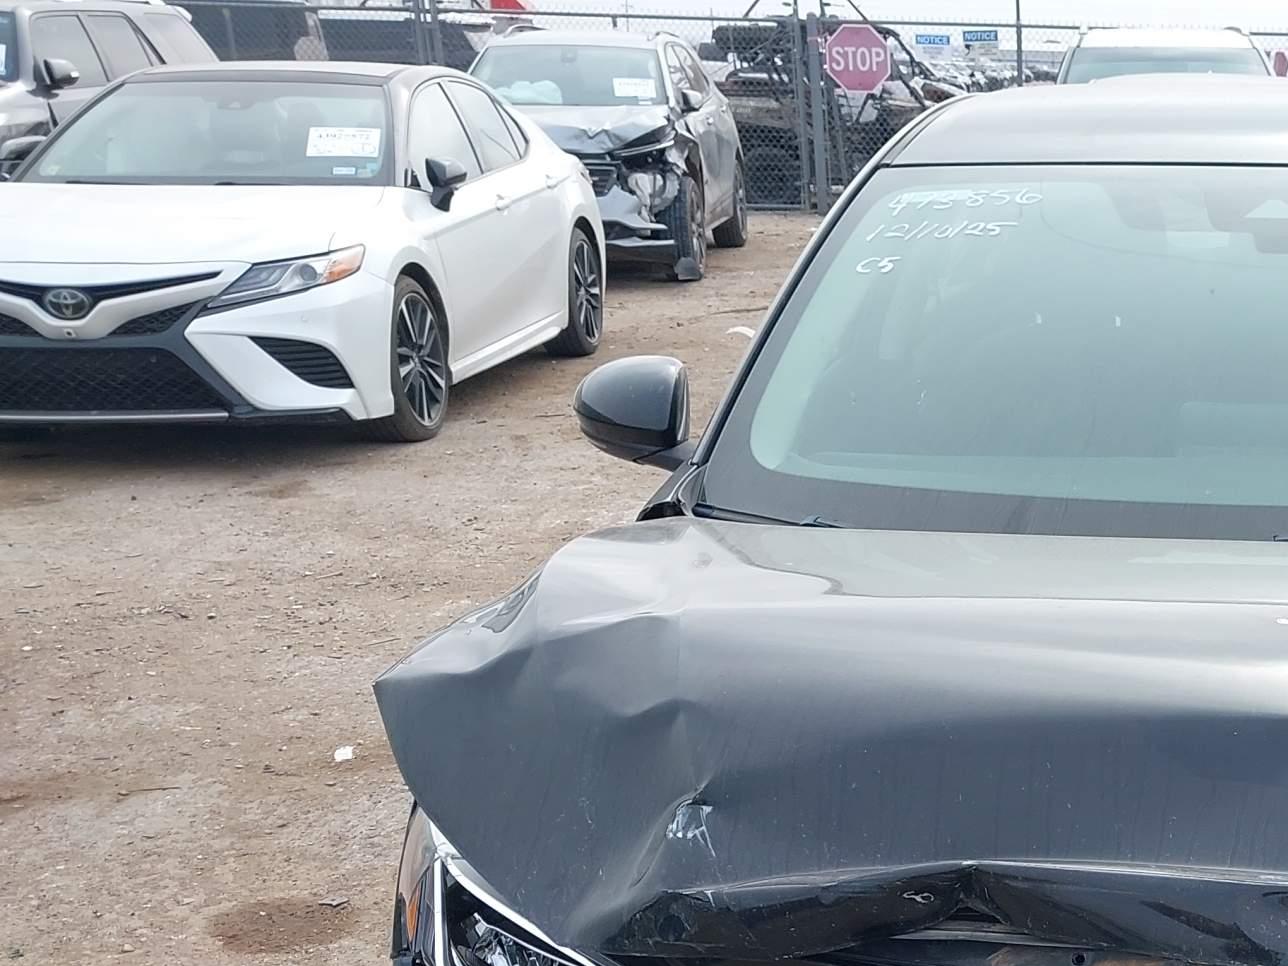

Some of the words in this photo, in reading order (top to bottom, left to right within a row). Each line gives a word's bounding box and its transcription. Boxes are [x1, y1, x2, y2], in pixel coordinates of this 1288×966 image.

[916, 36, 949, 46] NOTICE
[964, 32, 997, 41] NOTICE
[831, 47, 885, 72] STOP
[856, 256, 902, 273] C5
